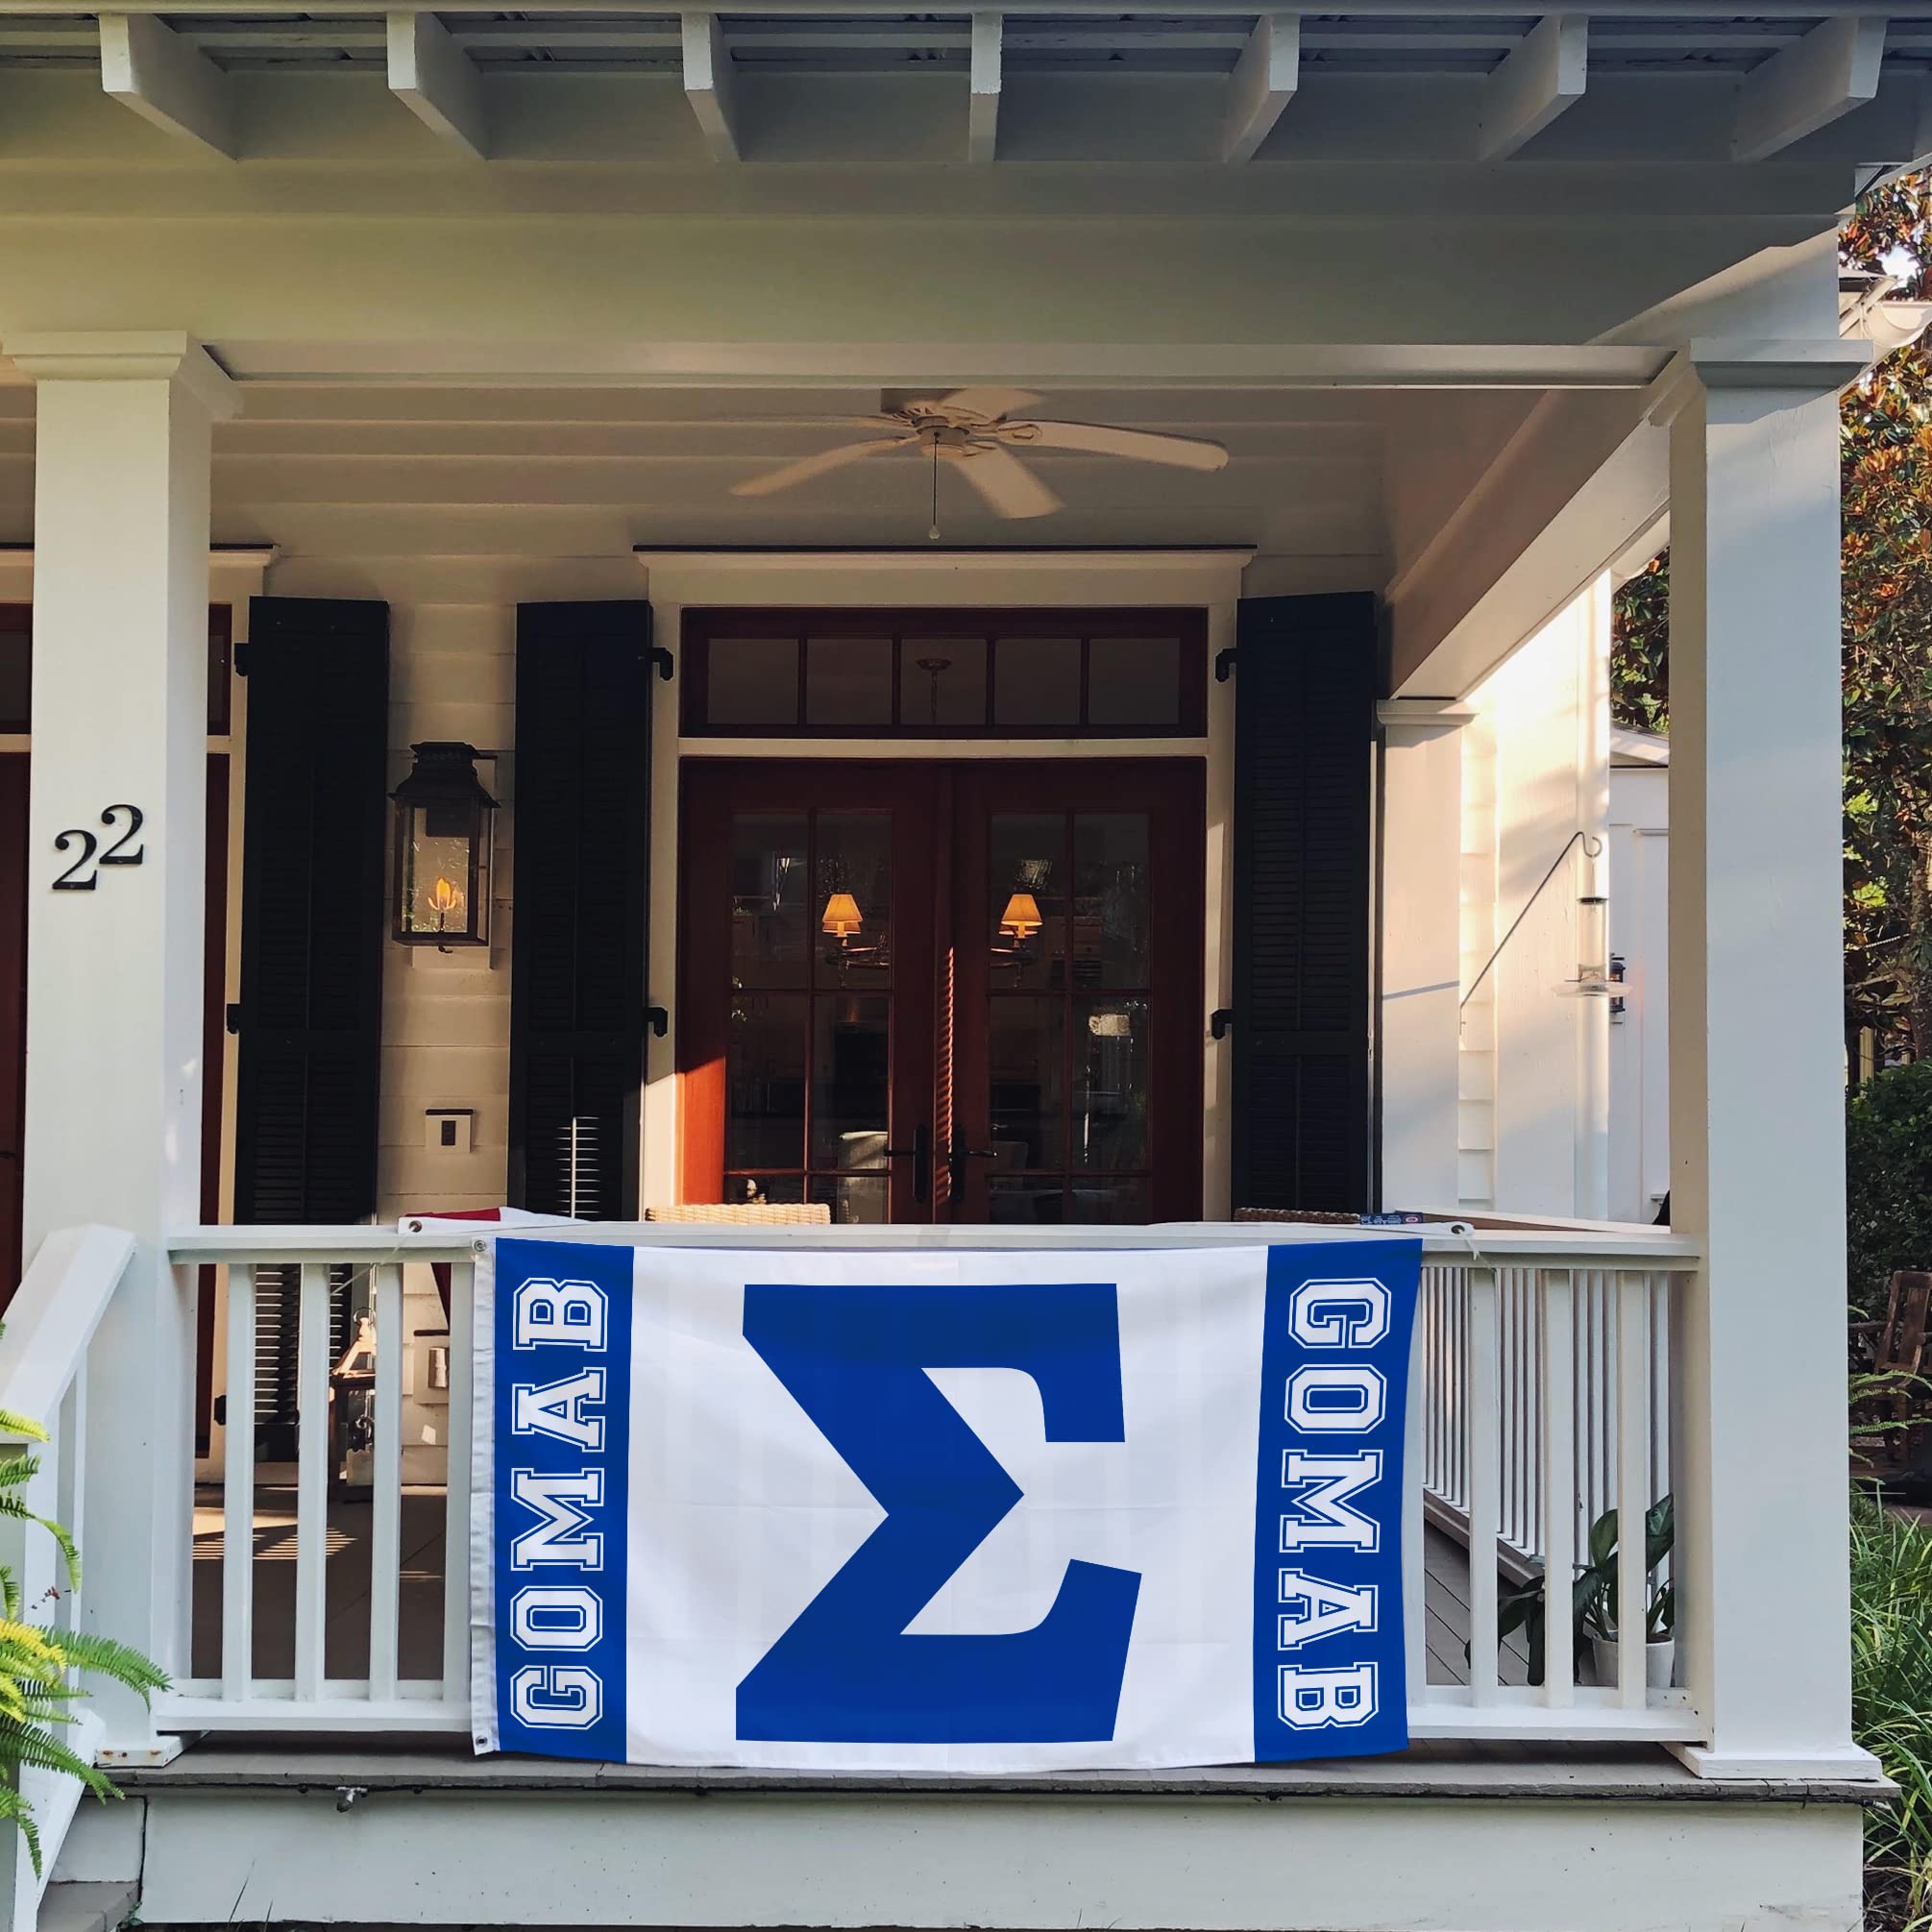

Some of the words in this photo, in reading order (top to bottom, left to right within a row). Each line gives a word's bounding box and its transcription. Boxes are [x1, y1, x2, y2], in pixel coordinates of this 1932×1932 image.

[52, 804, 143, 891] 22
[510, 1277, 608, 1730] GOMAB
[1277, 1277, 1392, 1731] GOMAB
